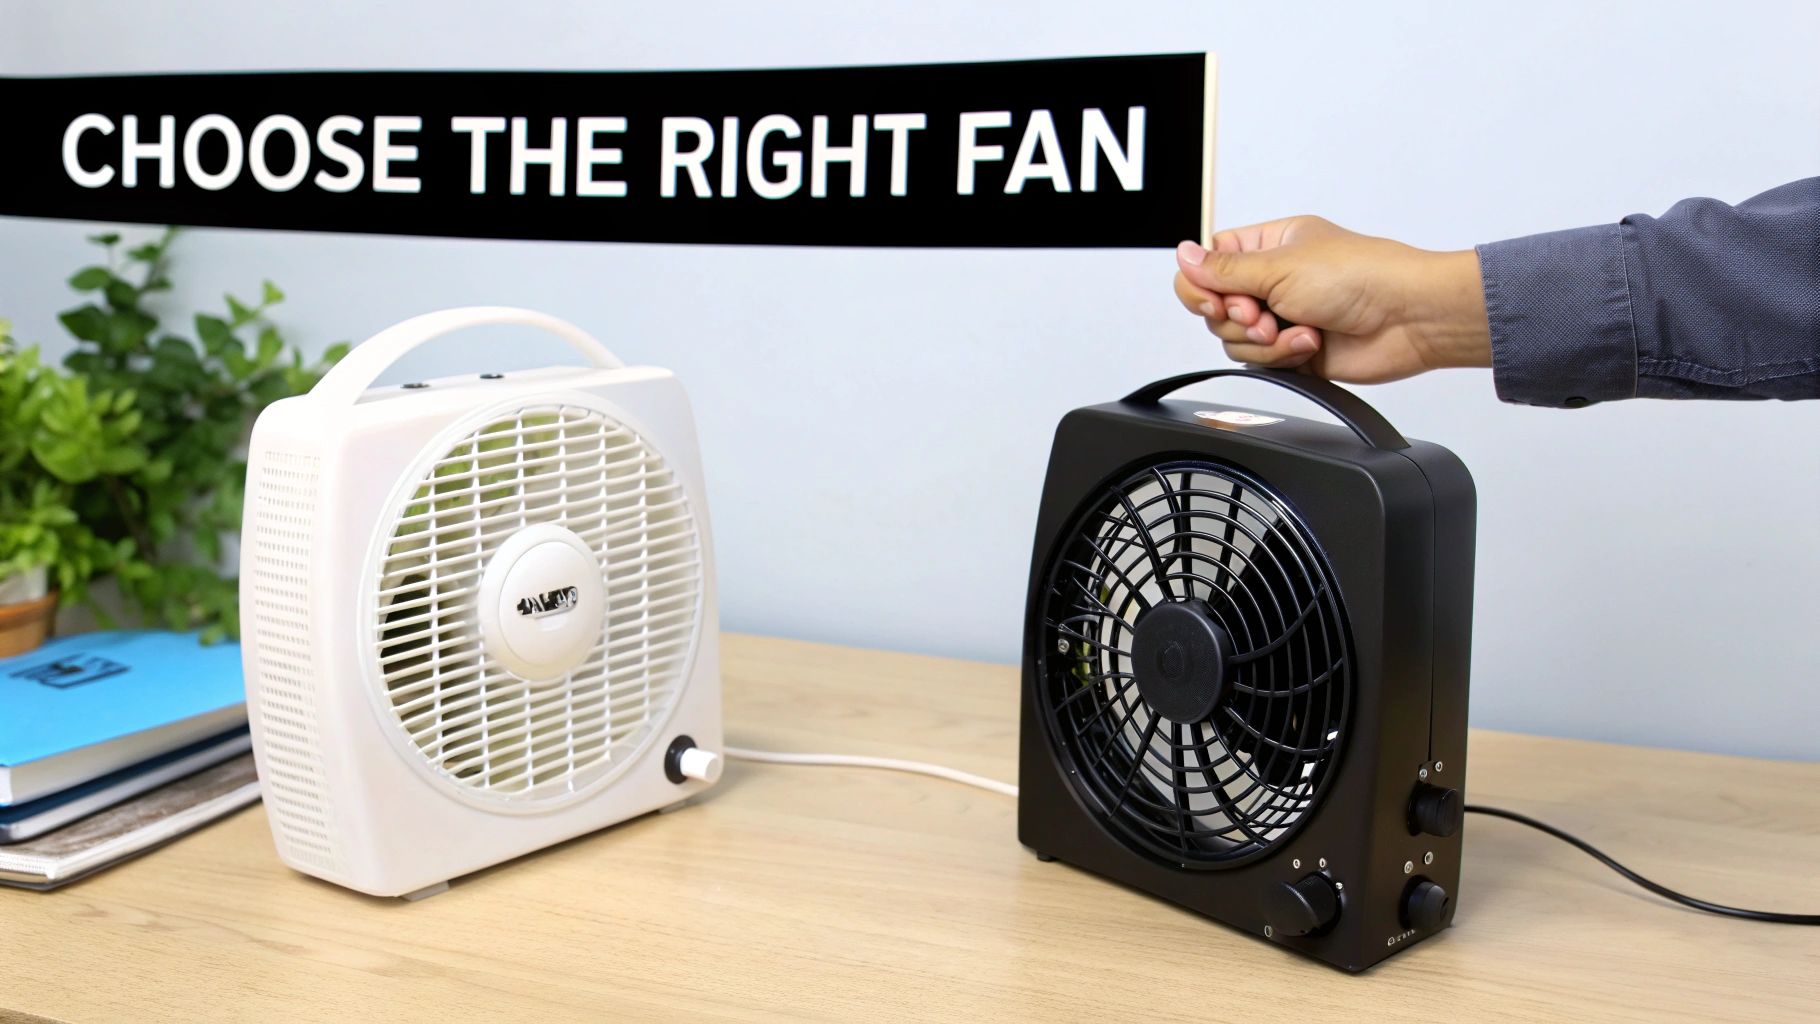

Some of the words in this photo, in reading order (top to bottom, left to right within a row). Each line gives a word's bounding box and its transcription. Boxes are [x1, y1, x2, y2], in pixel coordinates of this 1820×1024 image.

[62, 113, 423, 193] CHOOSE
[450, 116, 628, 197] THE
[660, 112, 927, 199] RIGHT
[956, 105, 1146, 196] FAN
